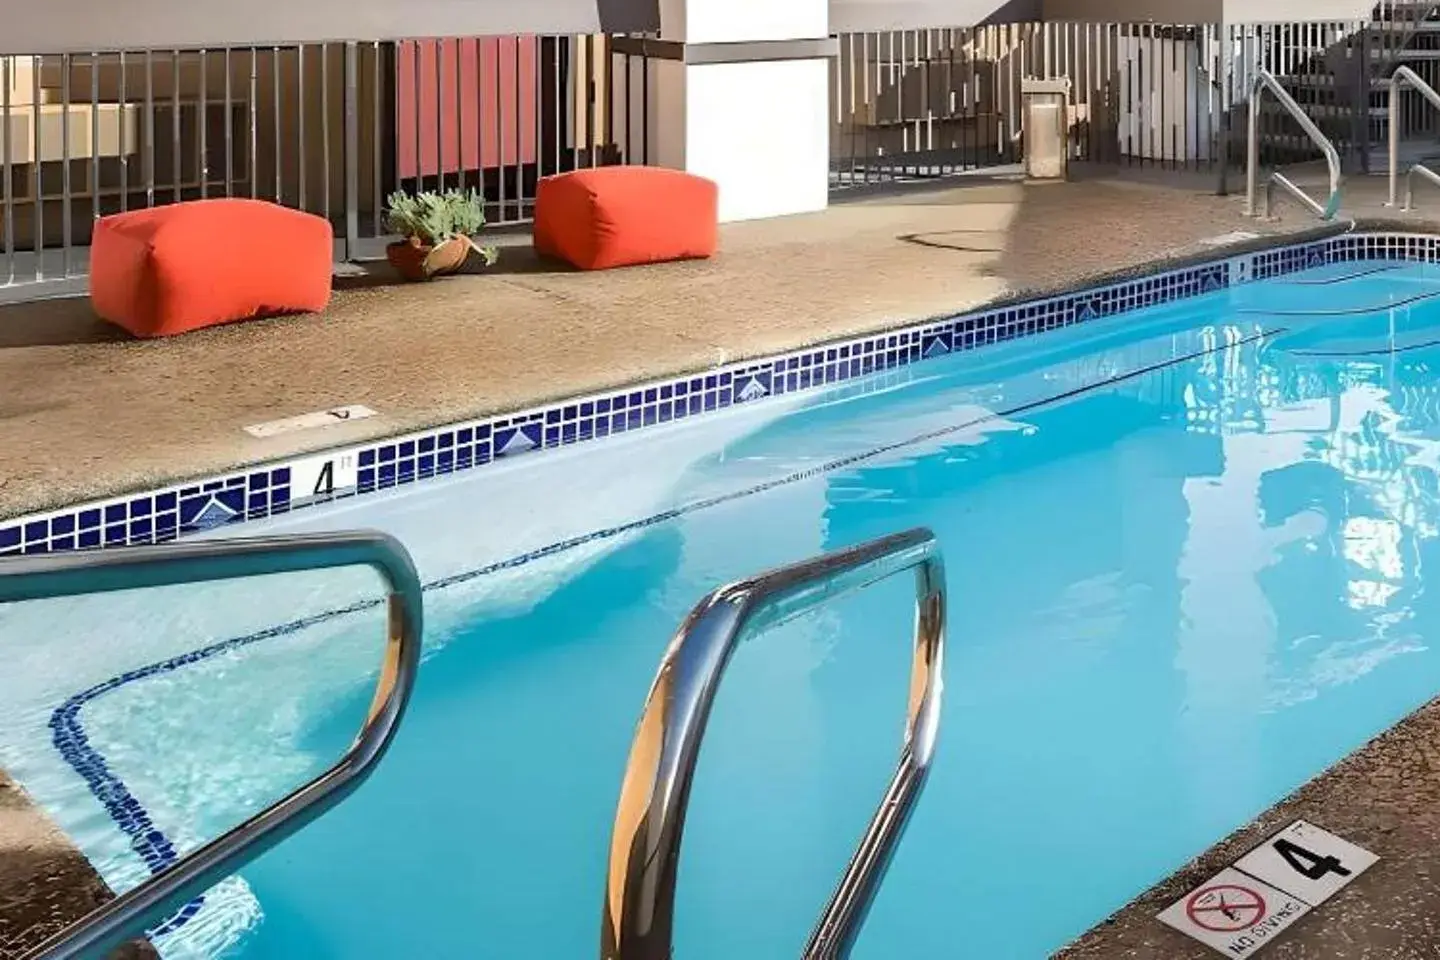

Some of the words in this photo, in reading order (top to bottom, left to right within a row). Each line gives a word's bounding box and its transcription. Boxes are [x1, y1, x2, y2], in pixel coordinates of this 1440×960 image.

[313, 460, 335, 494] 4
[1272, 838, 1352, 880] 4
[1228, 936, 1255, 955] NO
